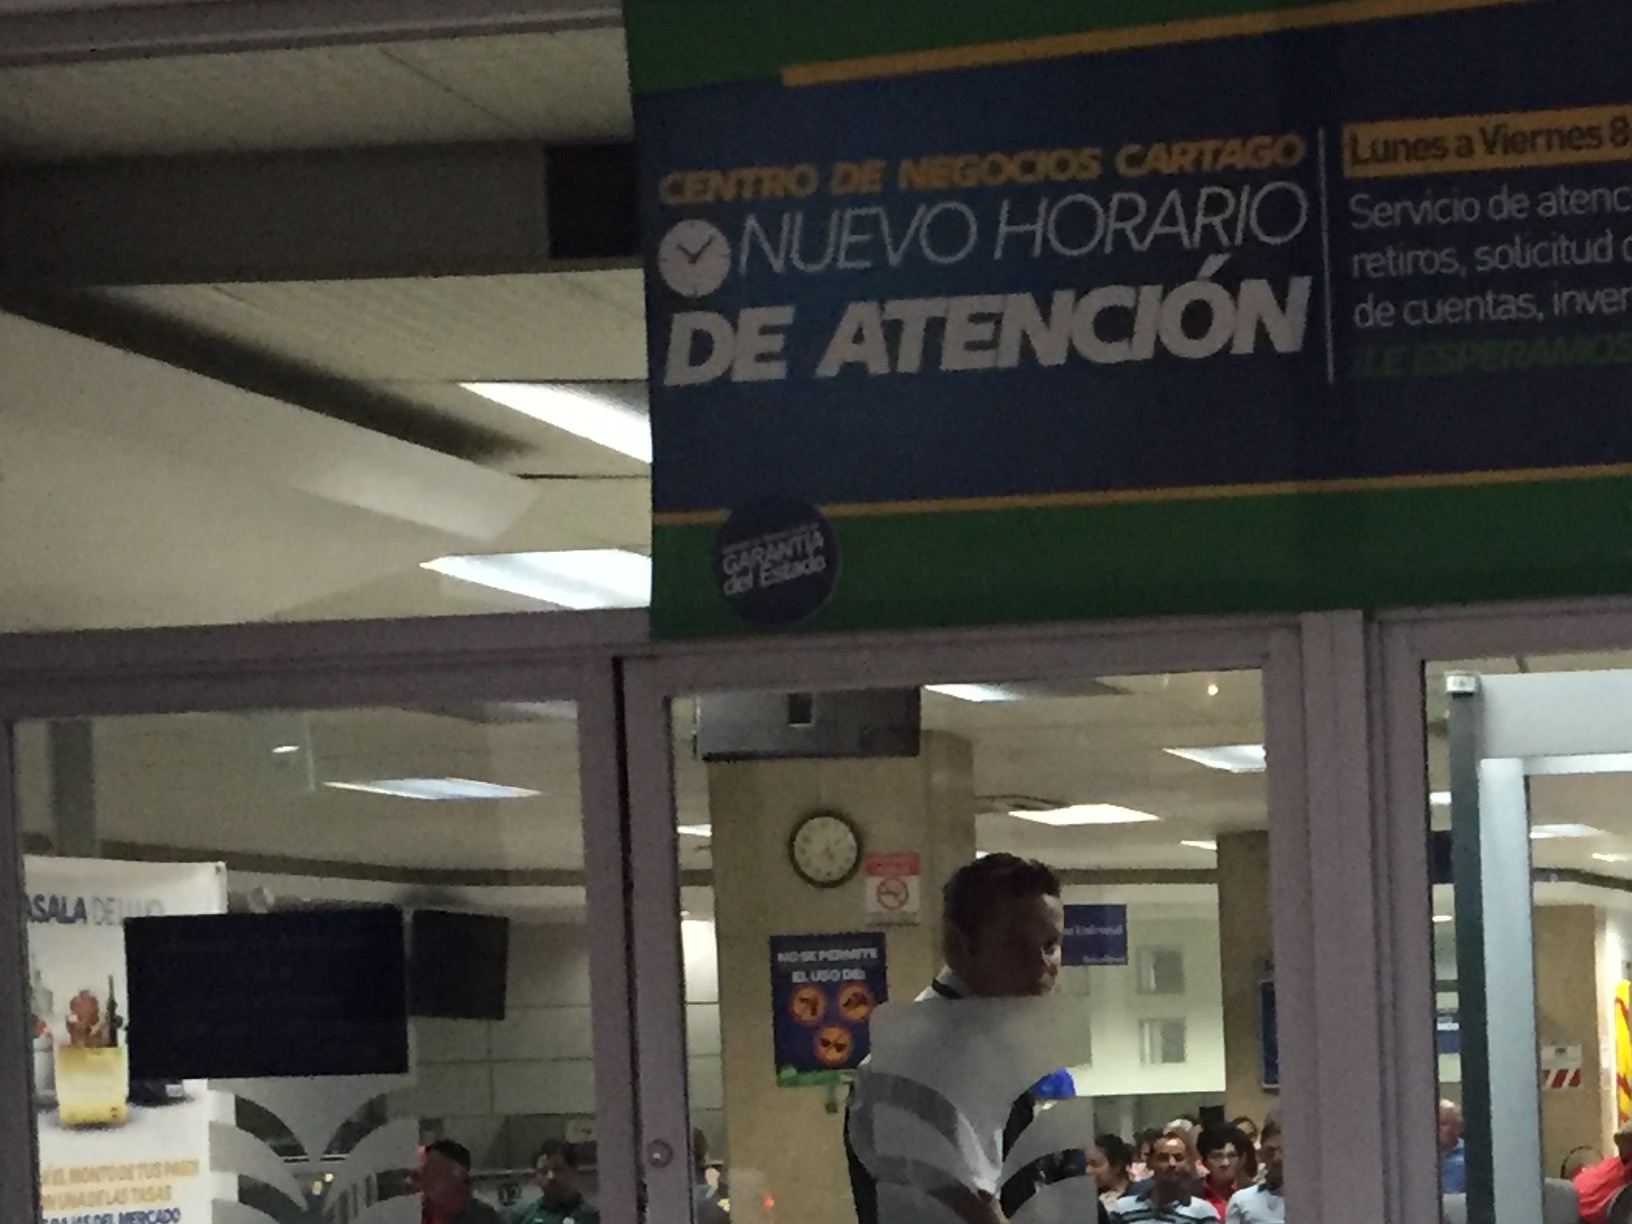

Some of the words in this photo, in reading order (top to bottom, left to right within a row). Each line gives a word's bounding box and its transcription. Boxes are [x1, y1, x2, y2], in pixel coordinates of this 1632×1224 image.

[660, 163, 819, 206] CENTRO
[830, 159, 887, 195] DE
[897, 147, 1103, 190] NEGOCIOS
[1114, 133, 1308, 177] CARTAGO
[1349, 131, 1449, 166] Lunes
[1455, 133, 1475, 159] a
[1479, 122, 1605, 156] Viernes
[738, 200, 978, 277] NUEVO
[994, 181, 1308, 260] HORARIO
[1349, 187, 1480, 230] Servicio
[1487, 182, 1531, 220] de
[1352, 242, 1468, 279] retiros,
[1474, 227, 1614, 272] solicitud
[663, 304, 796, 386] DE
[815, 253, 1313, 378] ATENCIÓN
[1353, 292, 1396, 328] de
[1402, 288, 1544, 326] cuentas,
